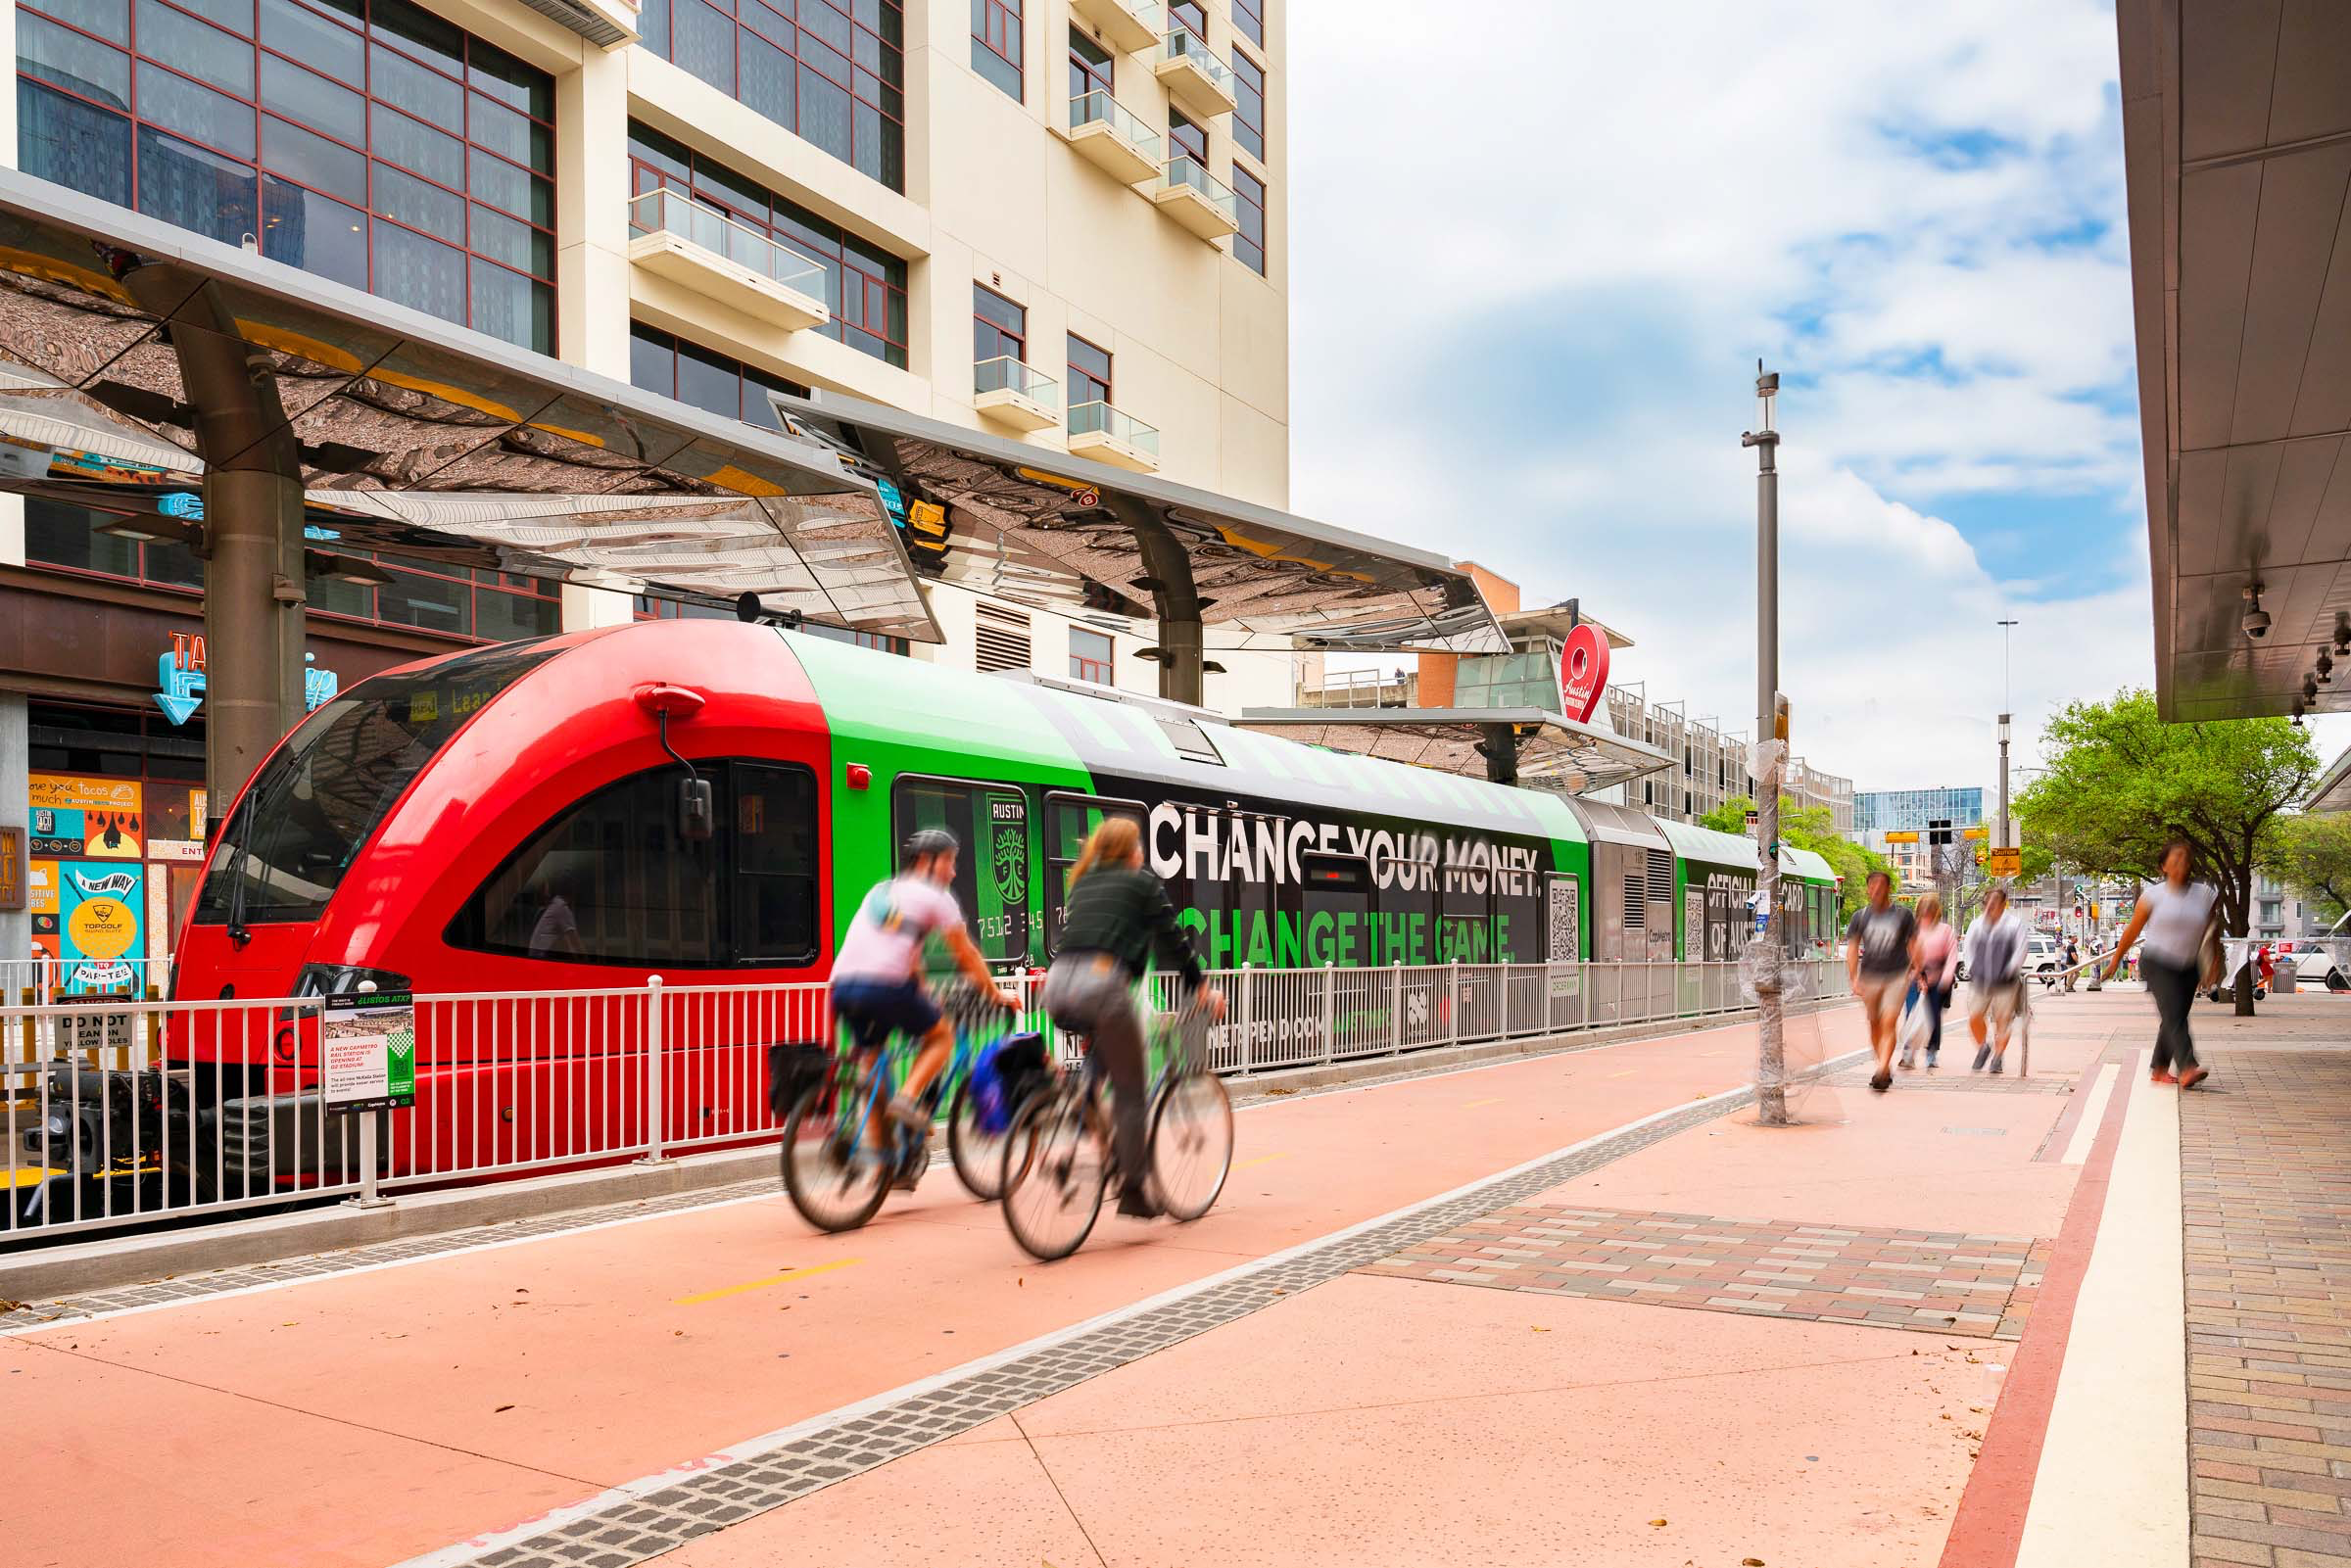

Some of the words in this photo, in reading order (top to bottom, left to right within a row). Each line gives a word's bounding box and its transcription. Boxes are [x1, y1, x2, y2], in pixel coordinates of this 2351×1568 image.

[1564, 678, 1592, 699] Austin
[31, 794, 61, 806] much
[992, 803, 1025, 819] AUSTIN
[1444, 837, 1542, 898] MONEY,
[81, 879, 86, 887] A
[88, 877, 112, 891] NEW
[110, 875, 133, 891] WAY
[977, 915, 1012, 940] 7512
[1178, 908, 1358, 973] CHANGE
[1364, 912, 1426, 968] THE
[1711, 923, 1727, 955] OF
[391, 994, 410, 1004] ATX?
[63, 1017, 86, 1028] DO
[92, 1015, 127, 1027] NOT
[64, 1038, 99, 1047] YLOW
